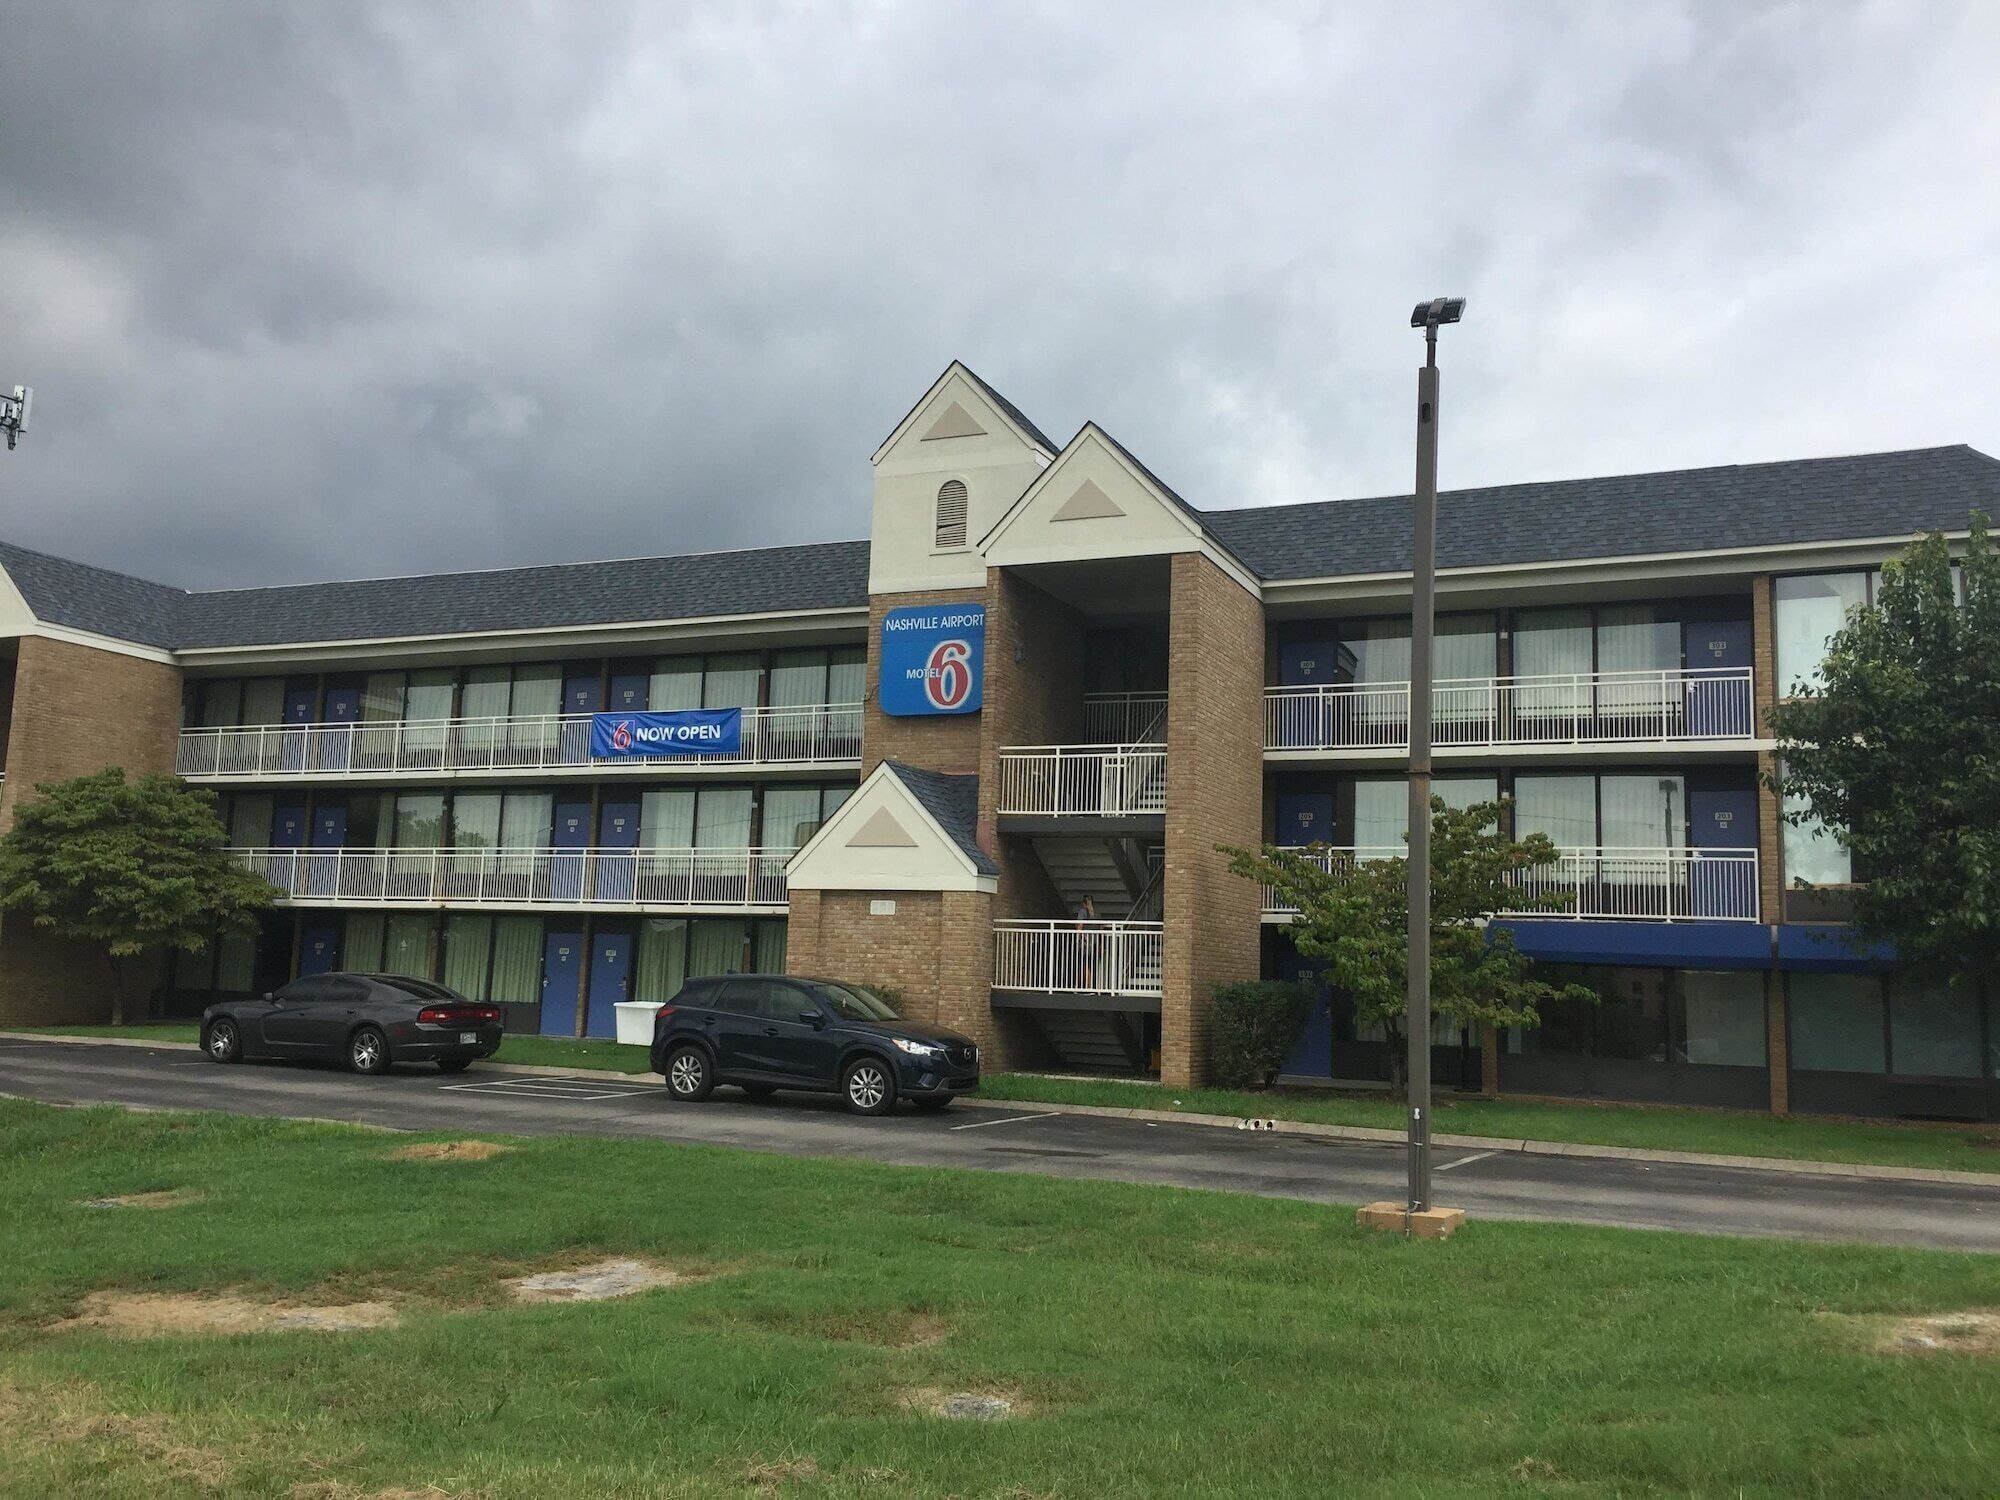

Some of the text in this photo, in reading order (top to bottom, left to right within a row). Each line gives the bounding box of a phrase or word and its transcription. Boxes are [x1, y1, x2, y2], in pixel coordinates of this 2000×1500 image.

[886, 614, 984, 631] NASHVILLE AIRPORT
[906, 640, 972, 709] MOTEL 6
[613, 720, 721, 750] 6 NOW OPEN
